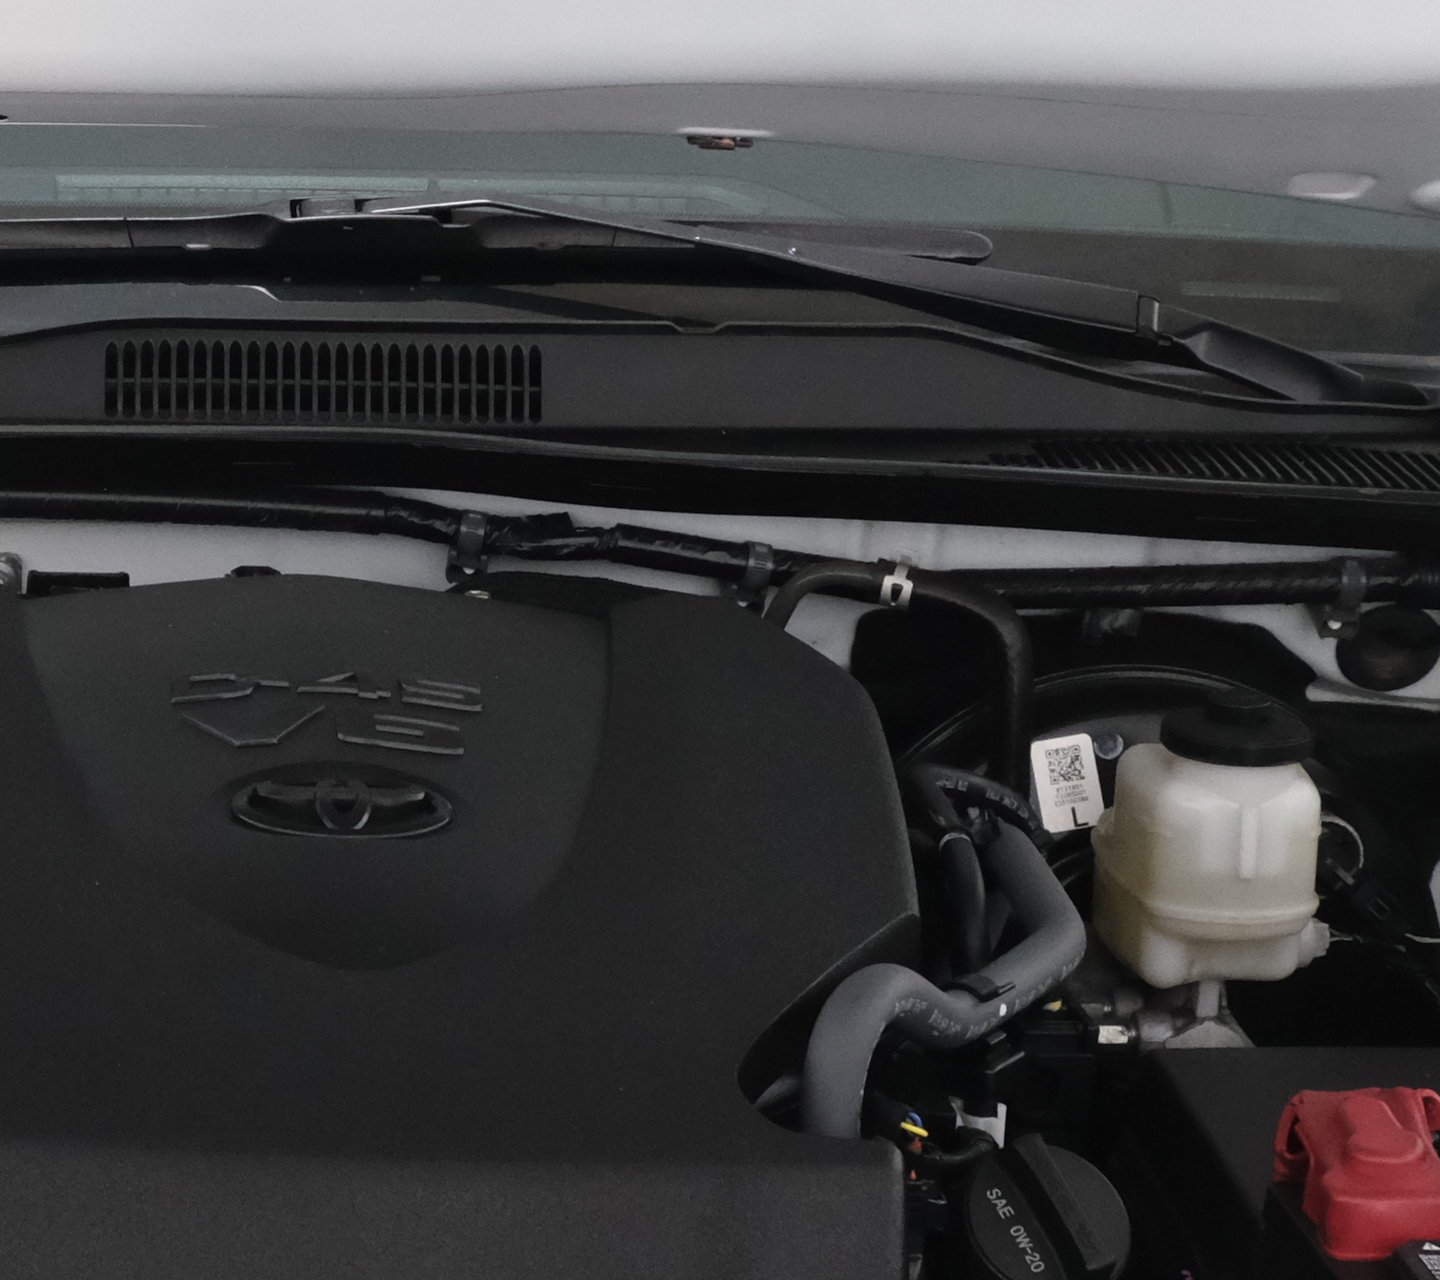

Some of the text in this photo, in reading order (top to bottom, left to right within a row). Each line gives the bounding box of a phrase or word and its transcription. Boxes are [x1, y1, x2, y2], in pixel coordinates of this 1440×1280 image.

[1071, 806, 1089, 827] L
[986, 1188, 1015, 1219] SAE
[1009, 1225, 1045, 1273] 0W-20
